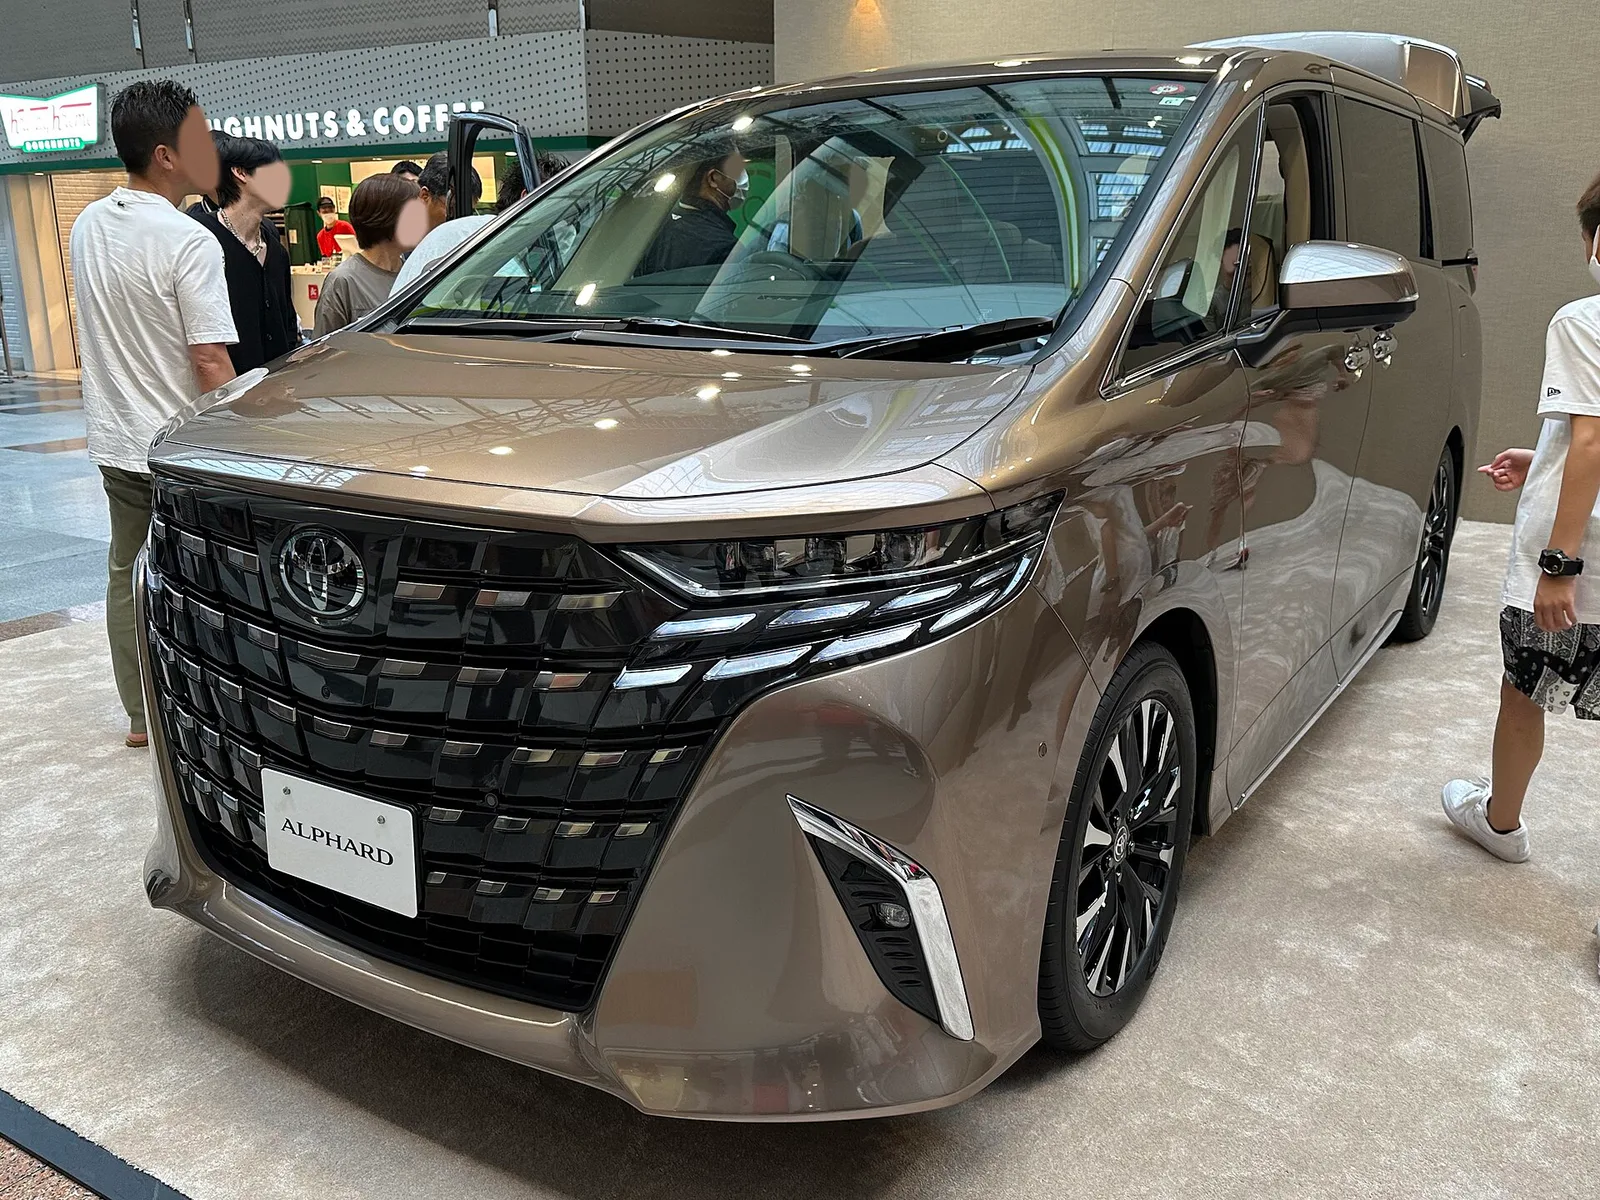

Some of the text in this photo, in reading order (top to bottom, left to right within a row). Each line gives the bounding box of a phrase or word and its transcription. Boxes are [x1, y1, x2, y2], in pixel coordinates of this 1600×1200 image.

[205, 110, 340, 141] UGHNUTS
[346, 109, 366, 137] &
[280, 817, 395, 867] ALPHARD
